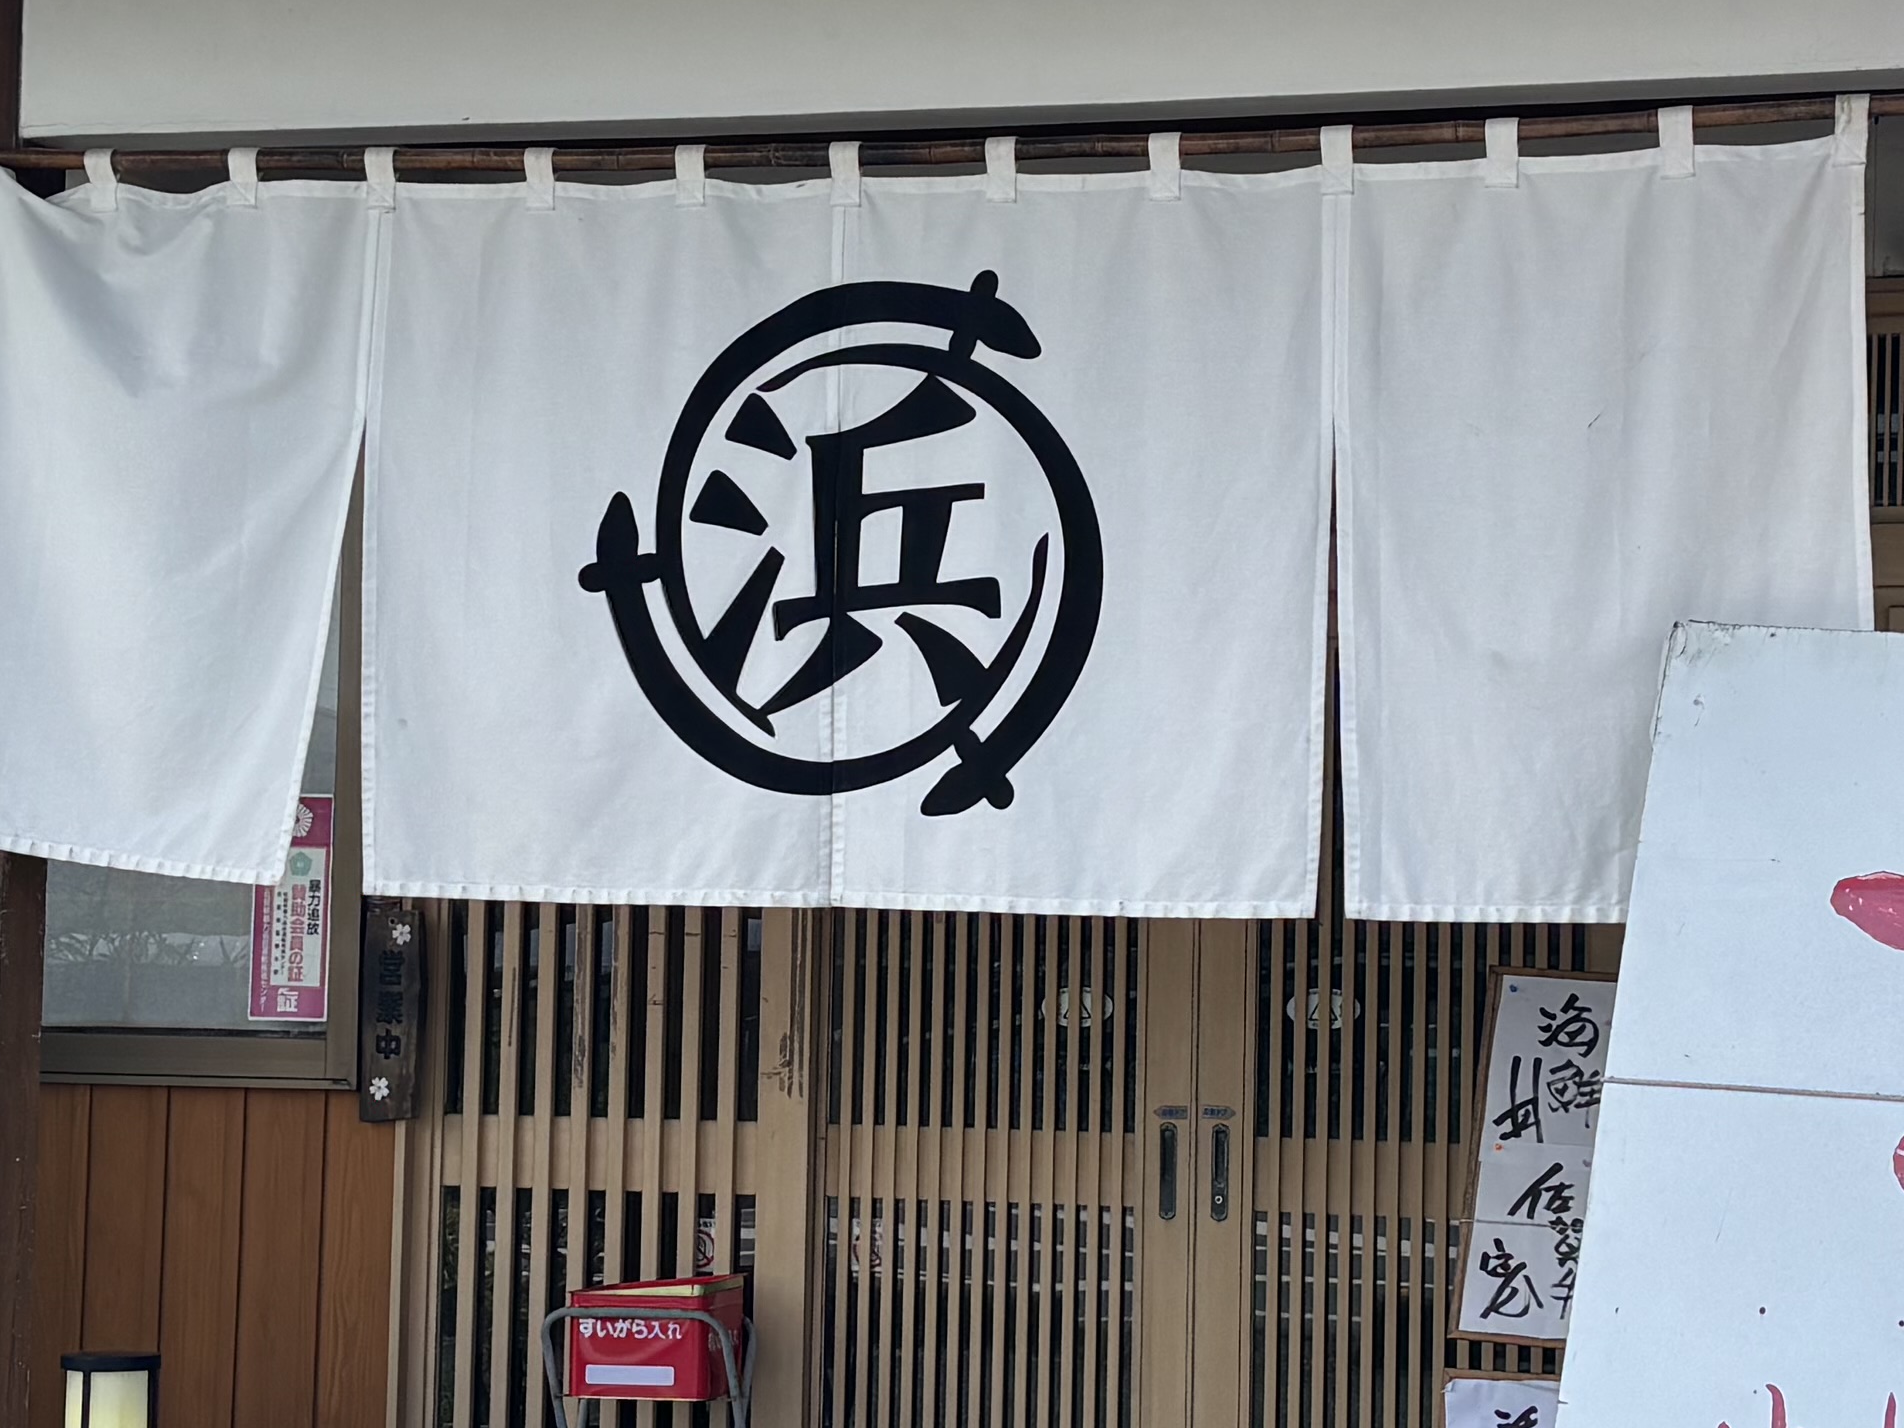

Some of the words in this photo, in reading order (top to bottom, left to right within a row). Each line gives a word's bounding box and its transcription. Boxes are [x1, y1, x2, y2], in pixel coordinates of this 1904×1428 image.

[681, 362, 1061, 762] 浜
[306, 879, 321, 935] 暴力追放
[375, 949, 405, 1059] 営業中
[579, 1318, 683, 1340] すいがら入れ
